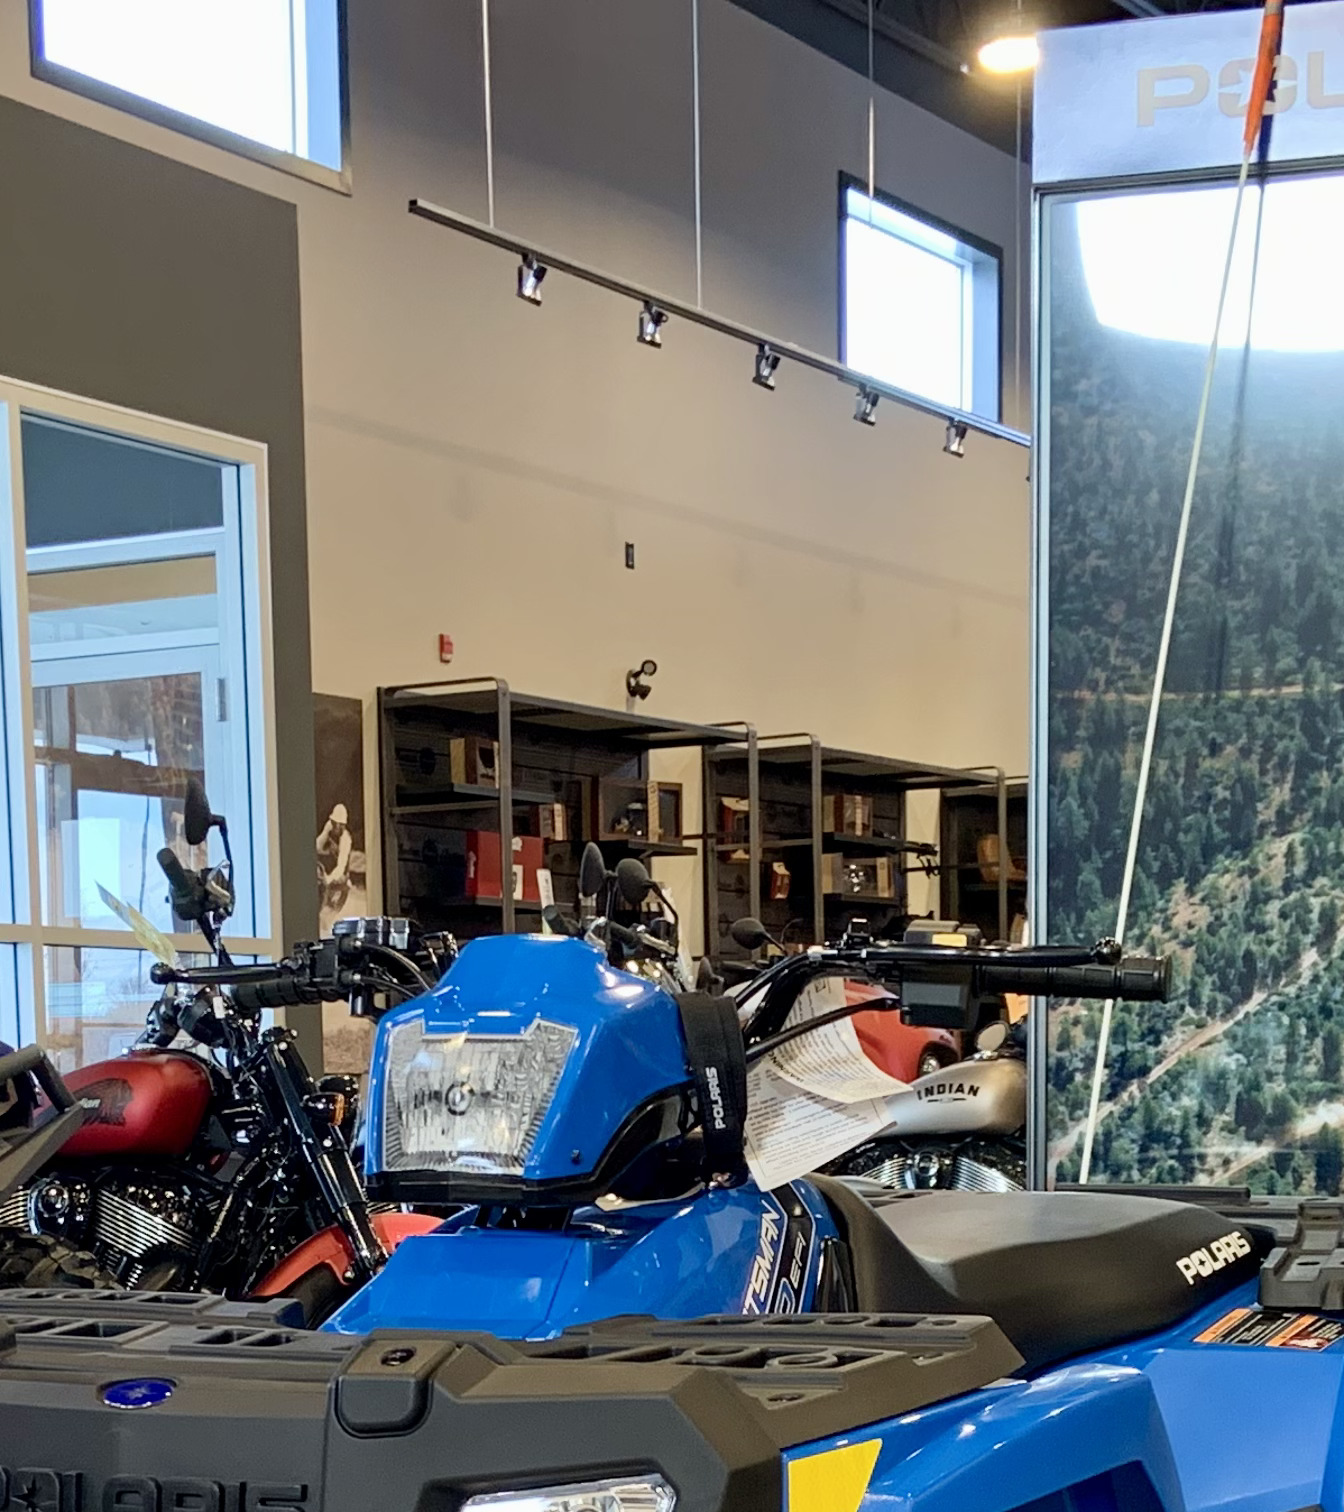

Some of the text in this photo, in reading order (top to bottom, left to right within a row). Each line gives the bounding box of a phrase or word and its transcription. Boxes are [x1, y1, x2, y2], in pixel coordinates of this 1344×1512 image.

[705, 1066, 726, 1129] POLARIS
[917, 1083, 980, 1100] INDIAN
[742, 1200, 780, 1314] TSMAN
[1176, 1231, 1252, 1285] POLARIS
